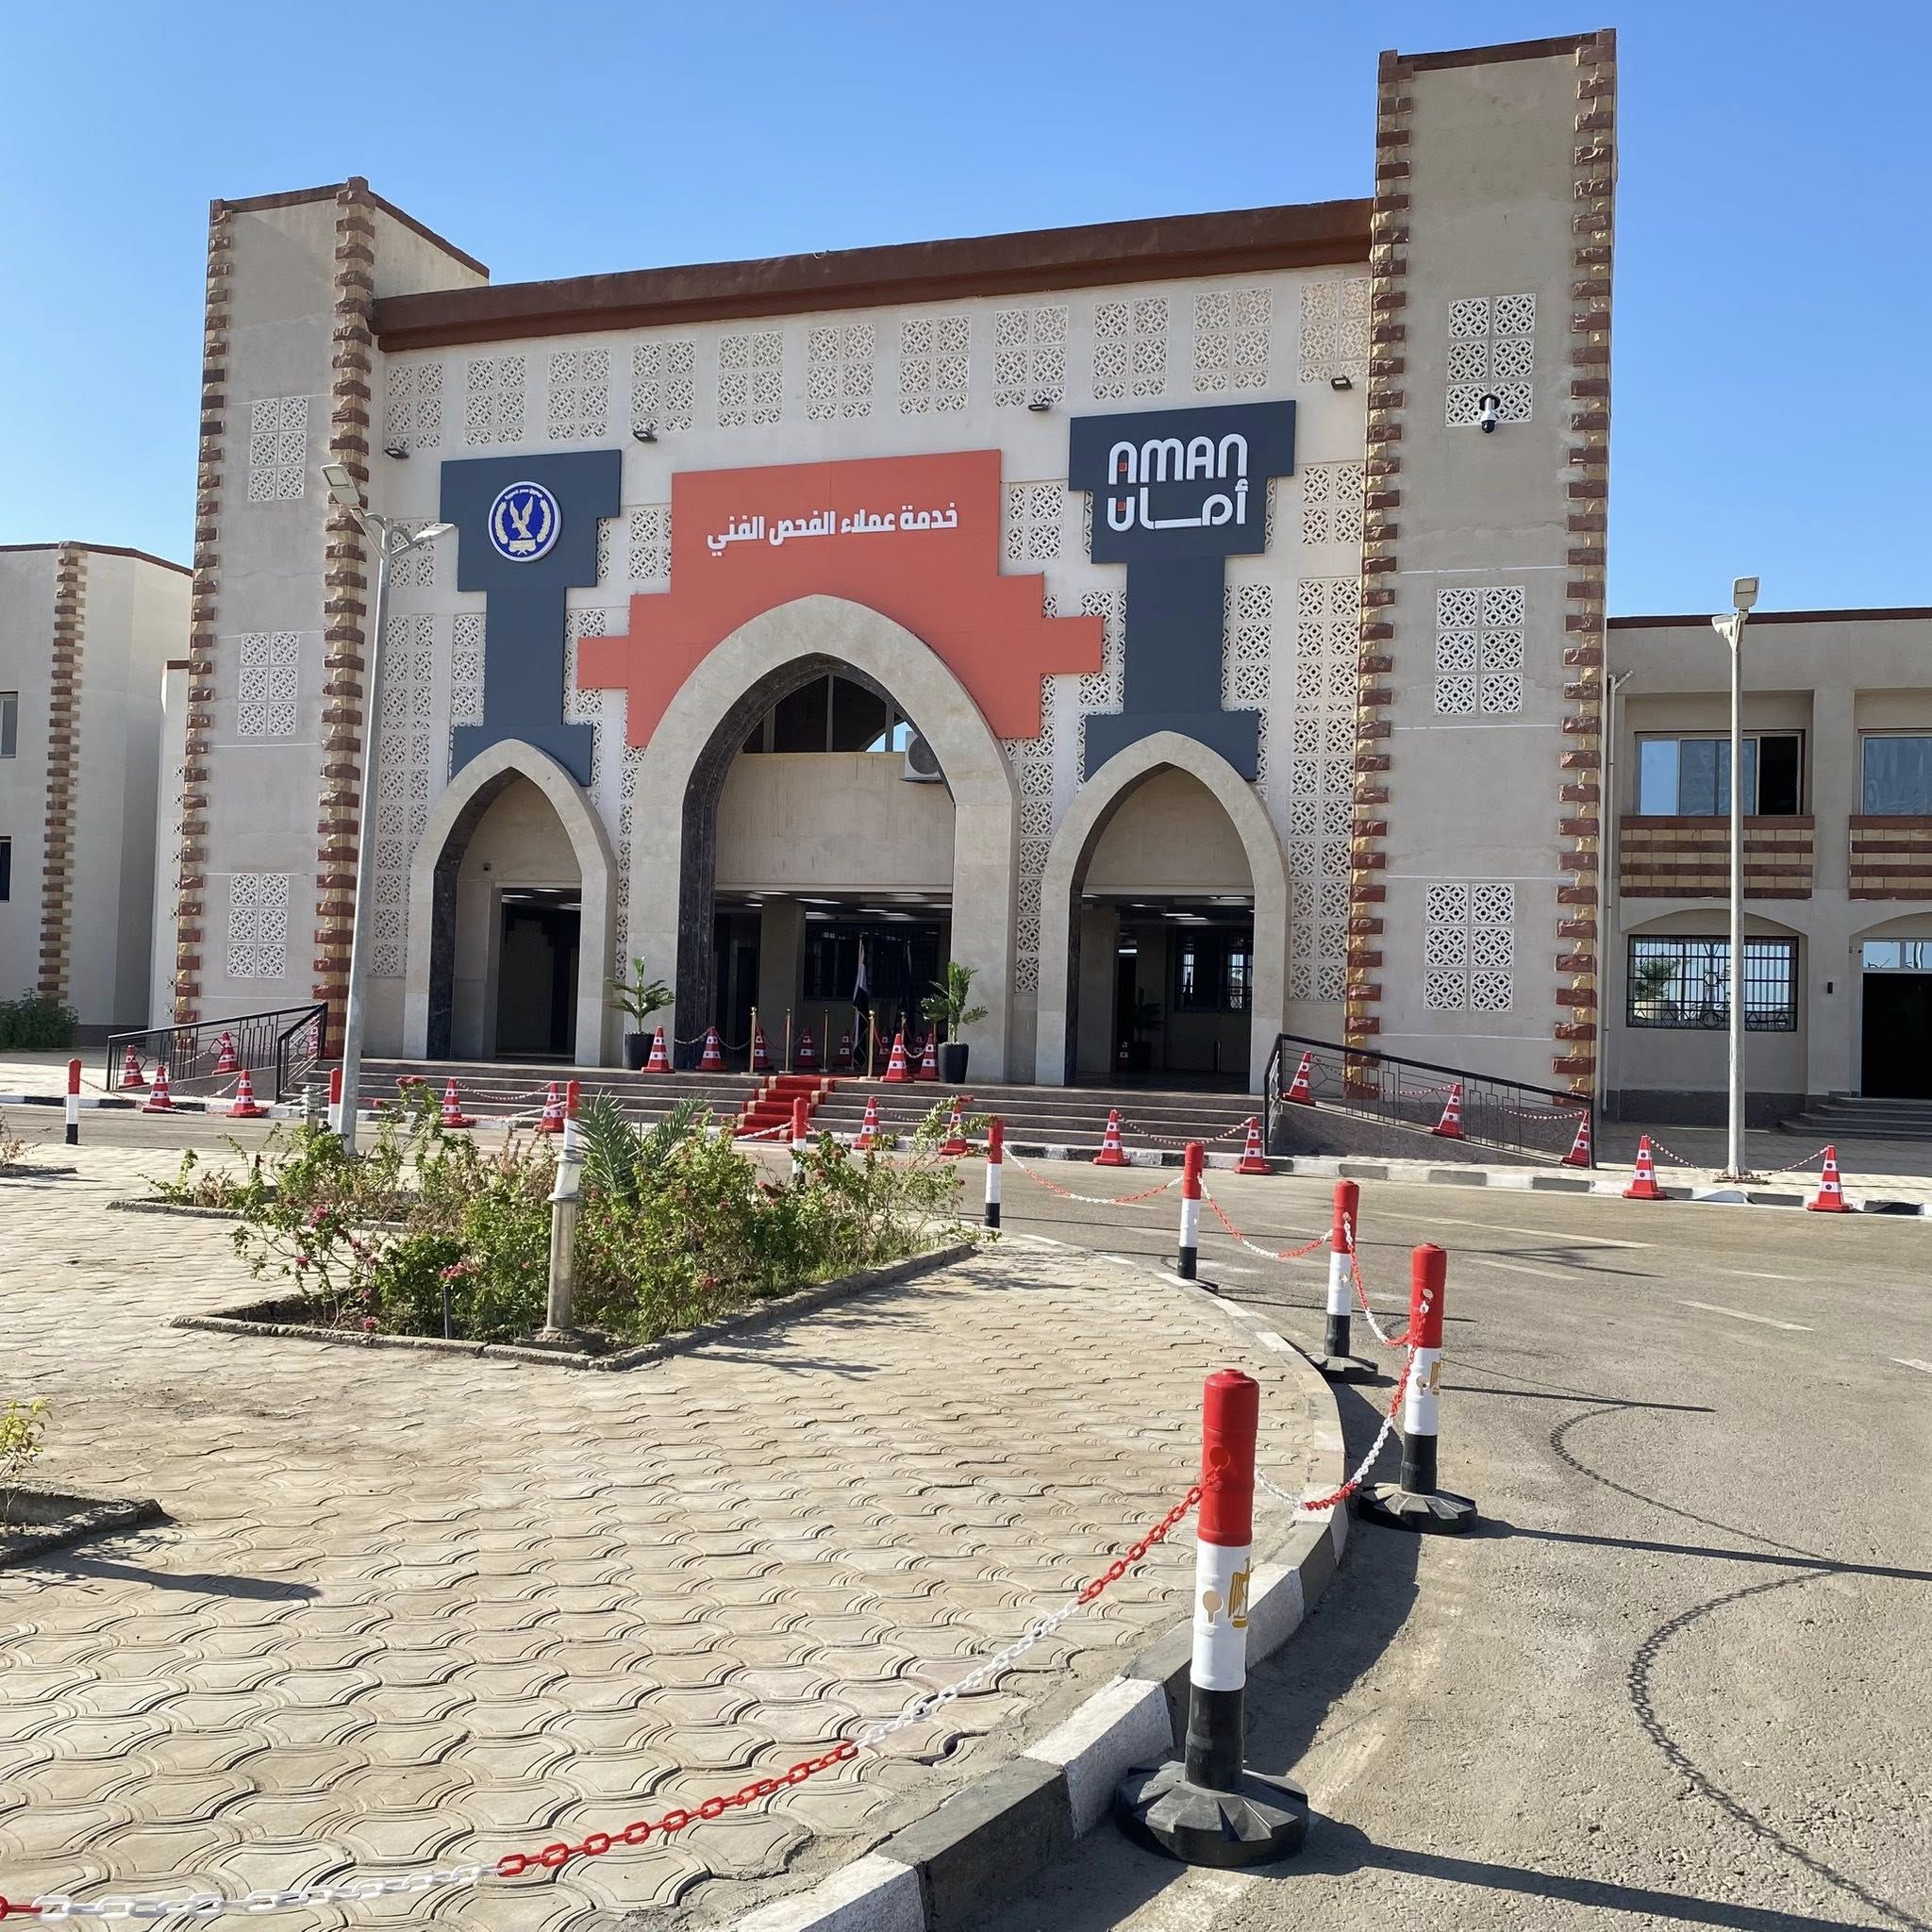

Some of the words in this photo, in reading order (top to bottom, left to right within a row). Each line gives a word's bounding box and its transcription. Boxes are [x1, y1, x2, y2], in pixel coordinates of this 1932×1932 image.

[1108, 433, 1248, 485] AMAN
[769, 509, 836, 546] الفحص
[841, 508, 896, 534] عملاء
[899, 502, 958, 530] خدمة
[707, 515, 765, 557] الفني
